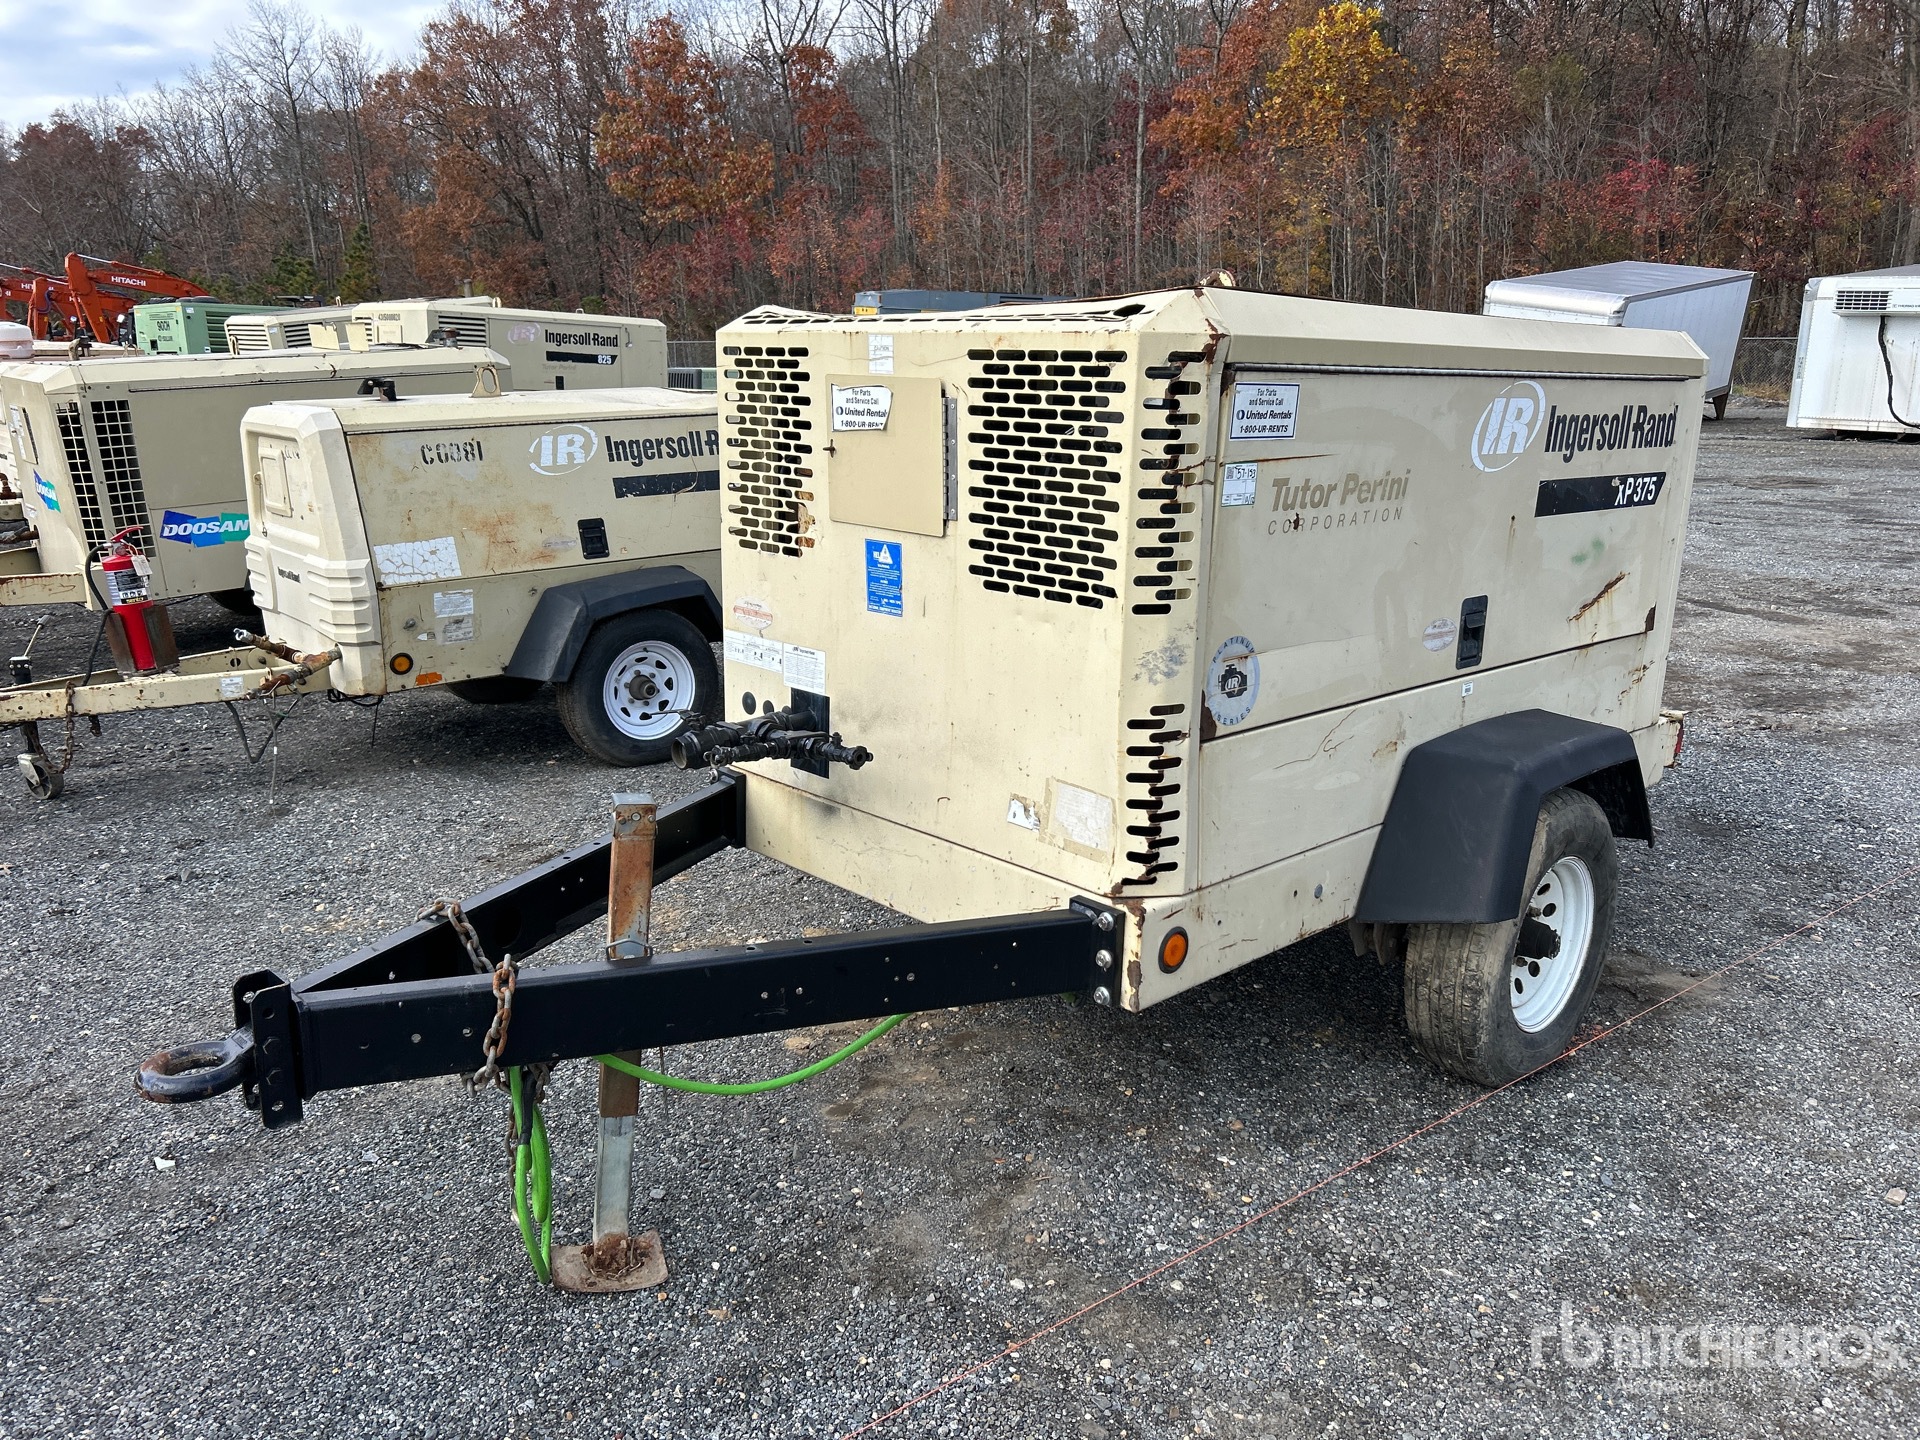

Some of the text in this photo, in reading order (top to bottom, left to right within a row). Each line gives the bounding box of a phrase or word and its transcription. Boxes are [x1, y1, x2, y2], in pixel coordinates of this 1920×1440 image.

[112, 276, 147, 287] HITACHI
[597, 354, 612, 364] 825
[1257, 388, 1277, 397] For Parts
[845, 396, 854, 404] and
[854, 397, 870, 405] Service
[1248, 398, 1284, 406] and Service Call
[844, 407, 865, 417] United
[1246, 410, 1292, 420] United Rentals
[1239, 424, 1289, 434] 1-800-UR-RENTS
[1272, 468, 1412, 512] Tutor Perini
[1267, 506, 1404, 535] CORPORATION
[162, 519, 249, 537] DOOSAN
[1216, 706, 1251, 726] SERIES
